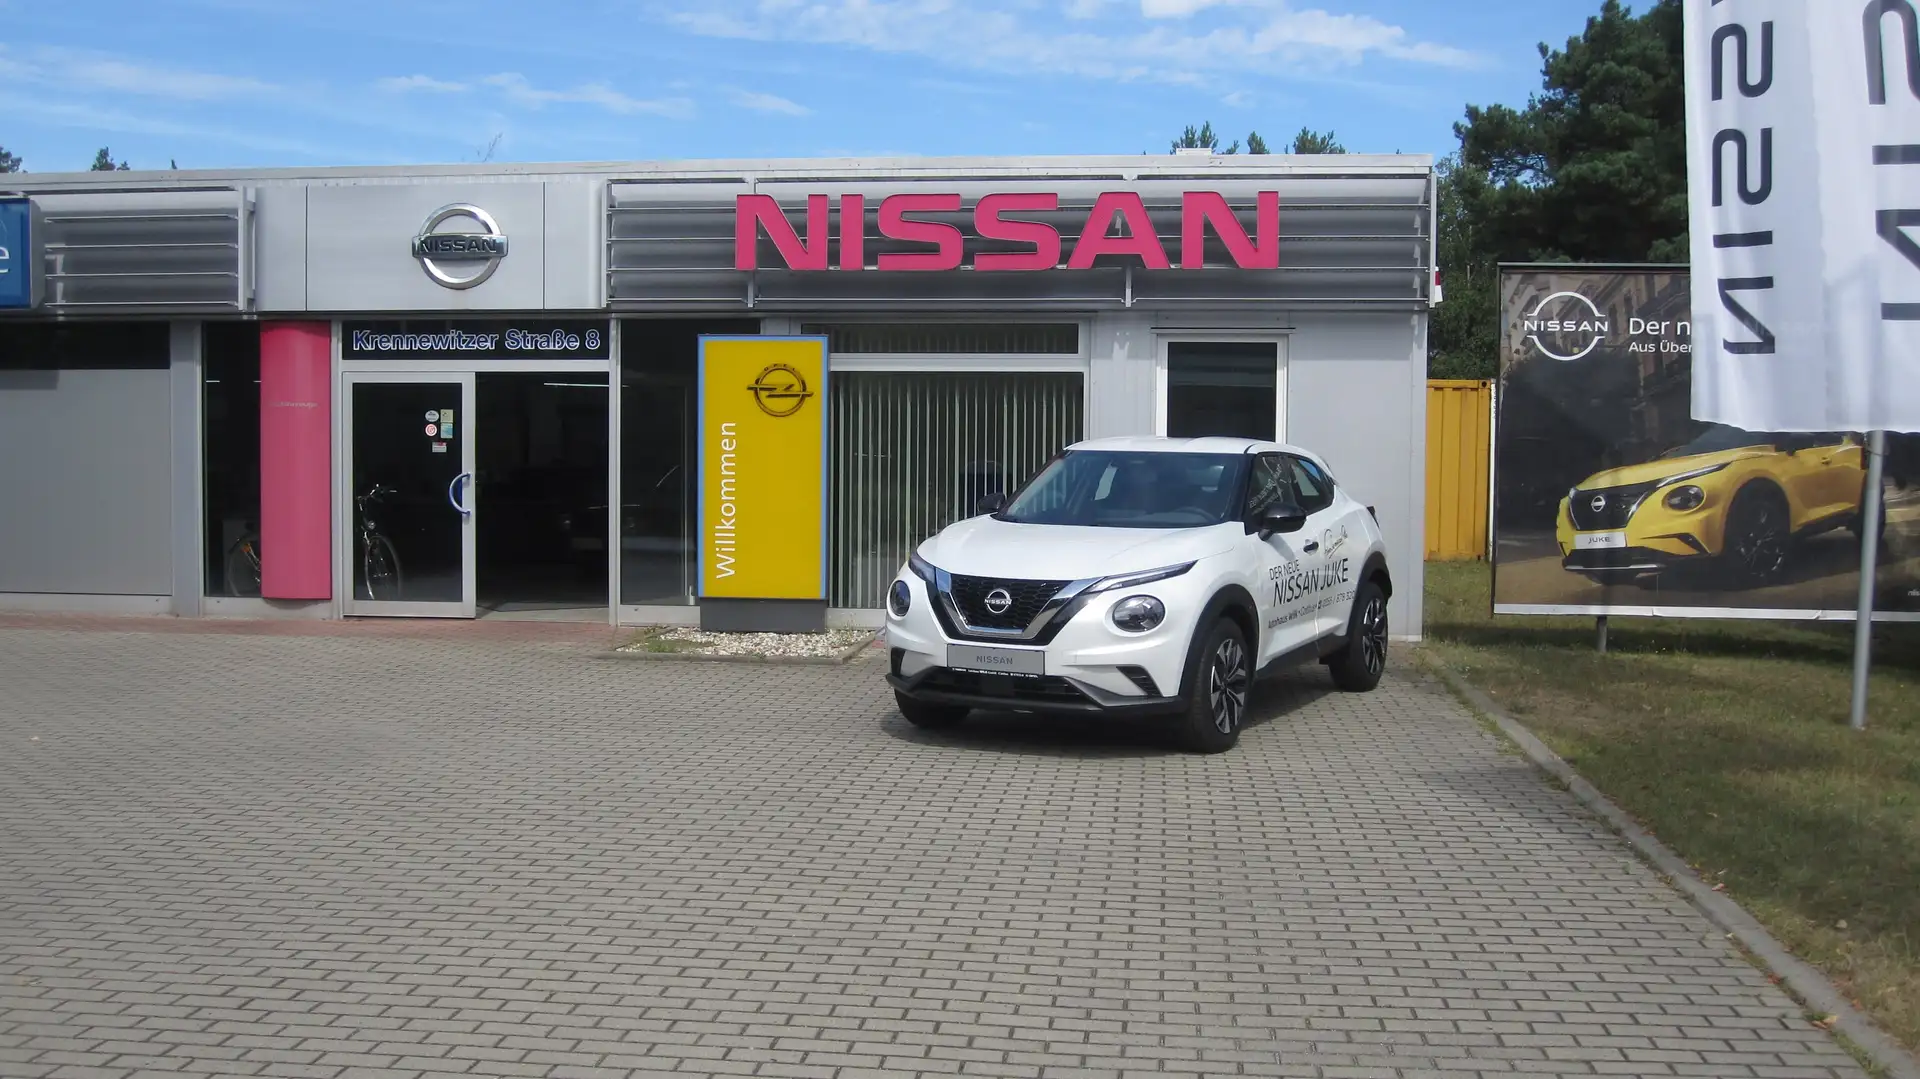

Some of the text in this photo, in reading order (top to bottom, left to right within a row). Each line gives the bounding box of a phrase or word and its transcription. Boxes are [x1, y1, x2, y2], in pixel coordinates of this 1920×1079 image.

[736, 191, 1280, 269] NISSAN
[420, 238, 498, 253] NISSAN
[1524, 320, 1608, 332] NISSAN
[1629, 317, 1670, 335] Der
[353, 328, 601, 351] Krennewitzer Straße 8
[1628, 341, 1656, 353] Aus
[714, 422, 737, 579] Willkommen
[1588, 536, 1611, 544] JUKE
[1269, 559, 1300, 581] DER NEUE
[1273, 558, 1348, 608] NISSAN JUKE
[976, 655, 1013, 665] NISSAN
